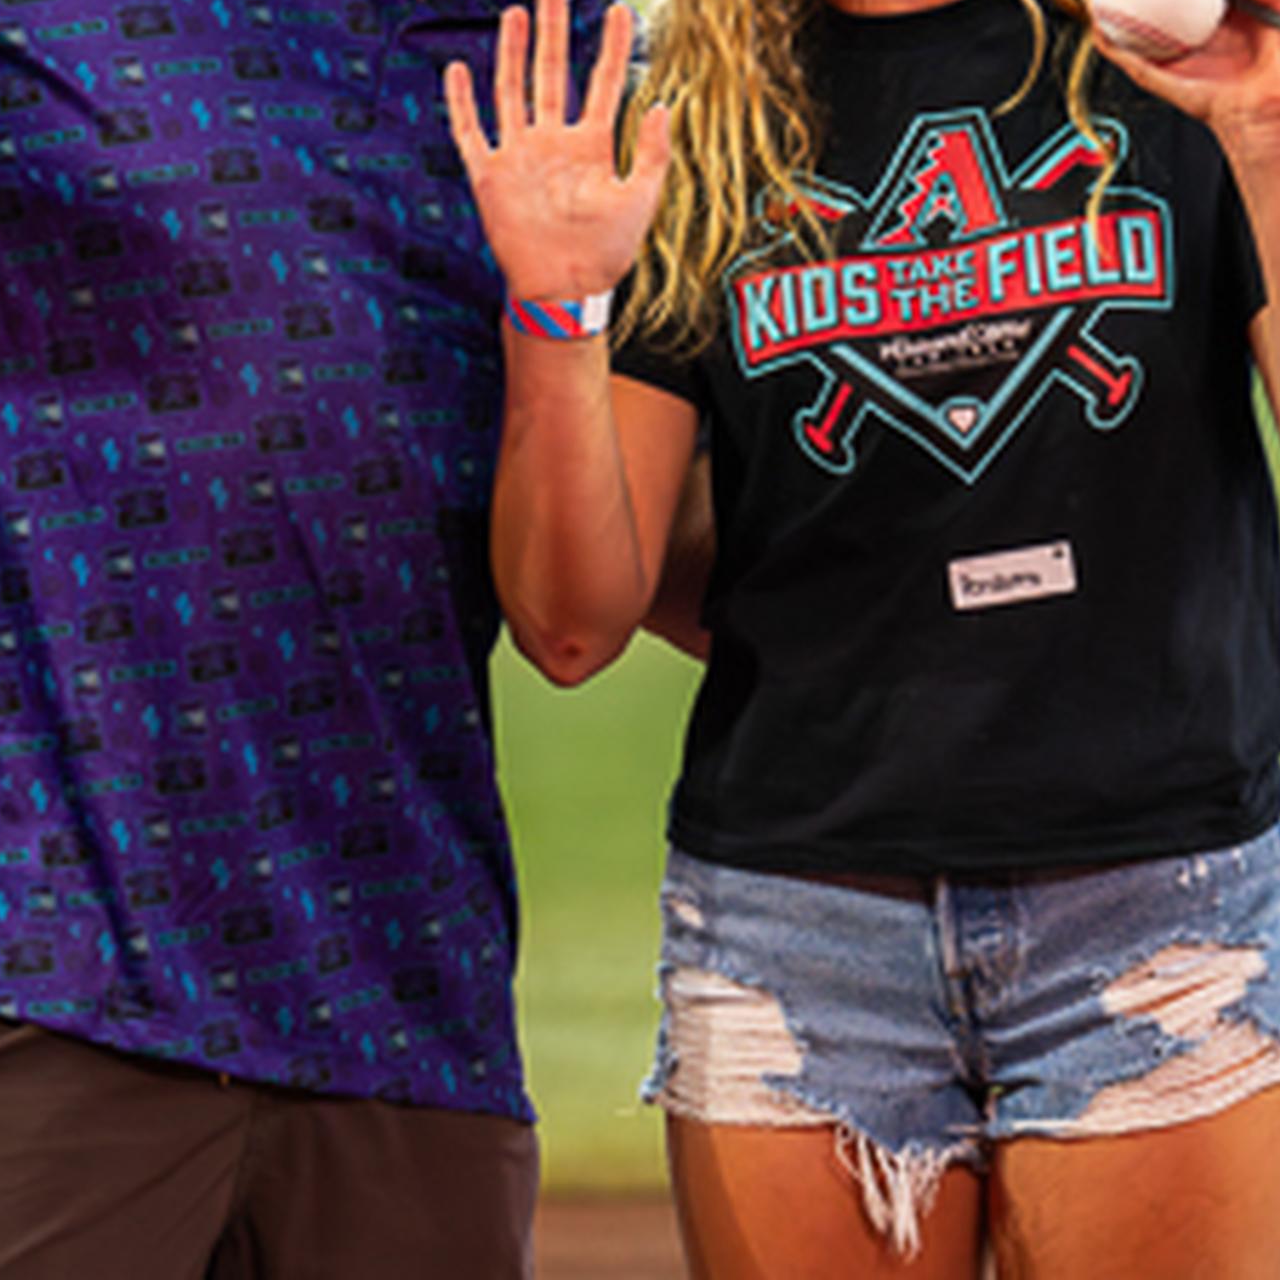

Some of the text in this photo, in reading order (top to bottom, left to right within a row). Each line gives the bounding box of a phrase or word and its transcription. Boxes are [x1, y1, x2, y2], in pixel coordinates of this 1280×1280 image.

[886, 250, 976, 286] TAKE
[986, 215, 1158, 302] FIELD
[743, 261, 882, 351] KIDS
[888, 277, 979, 321] THE
